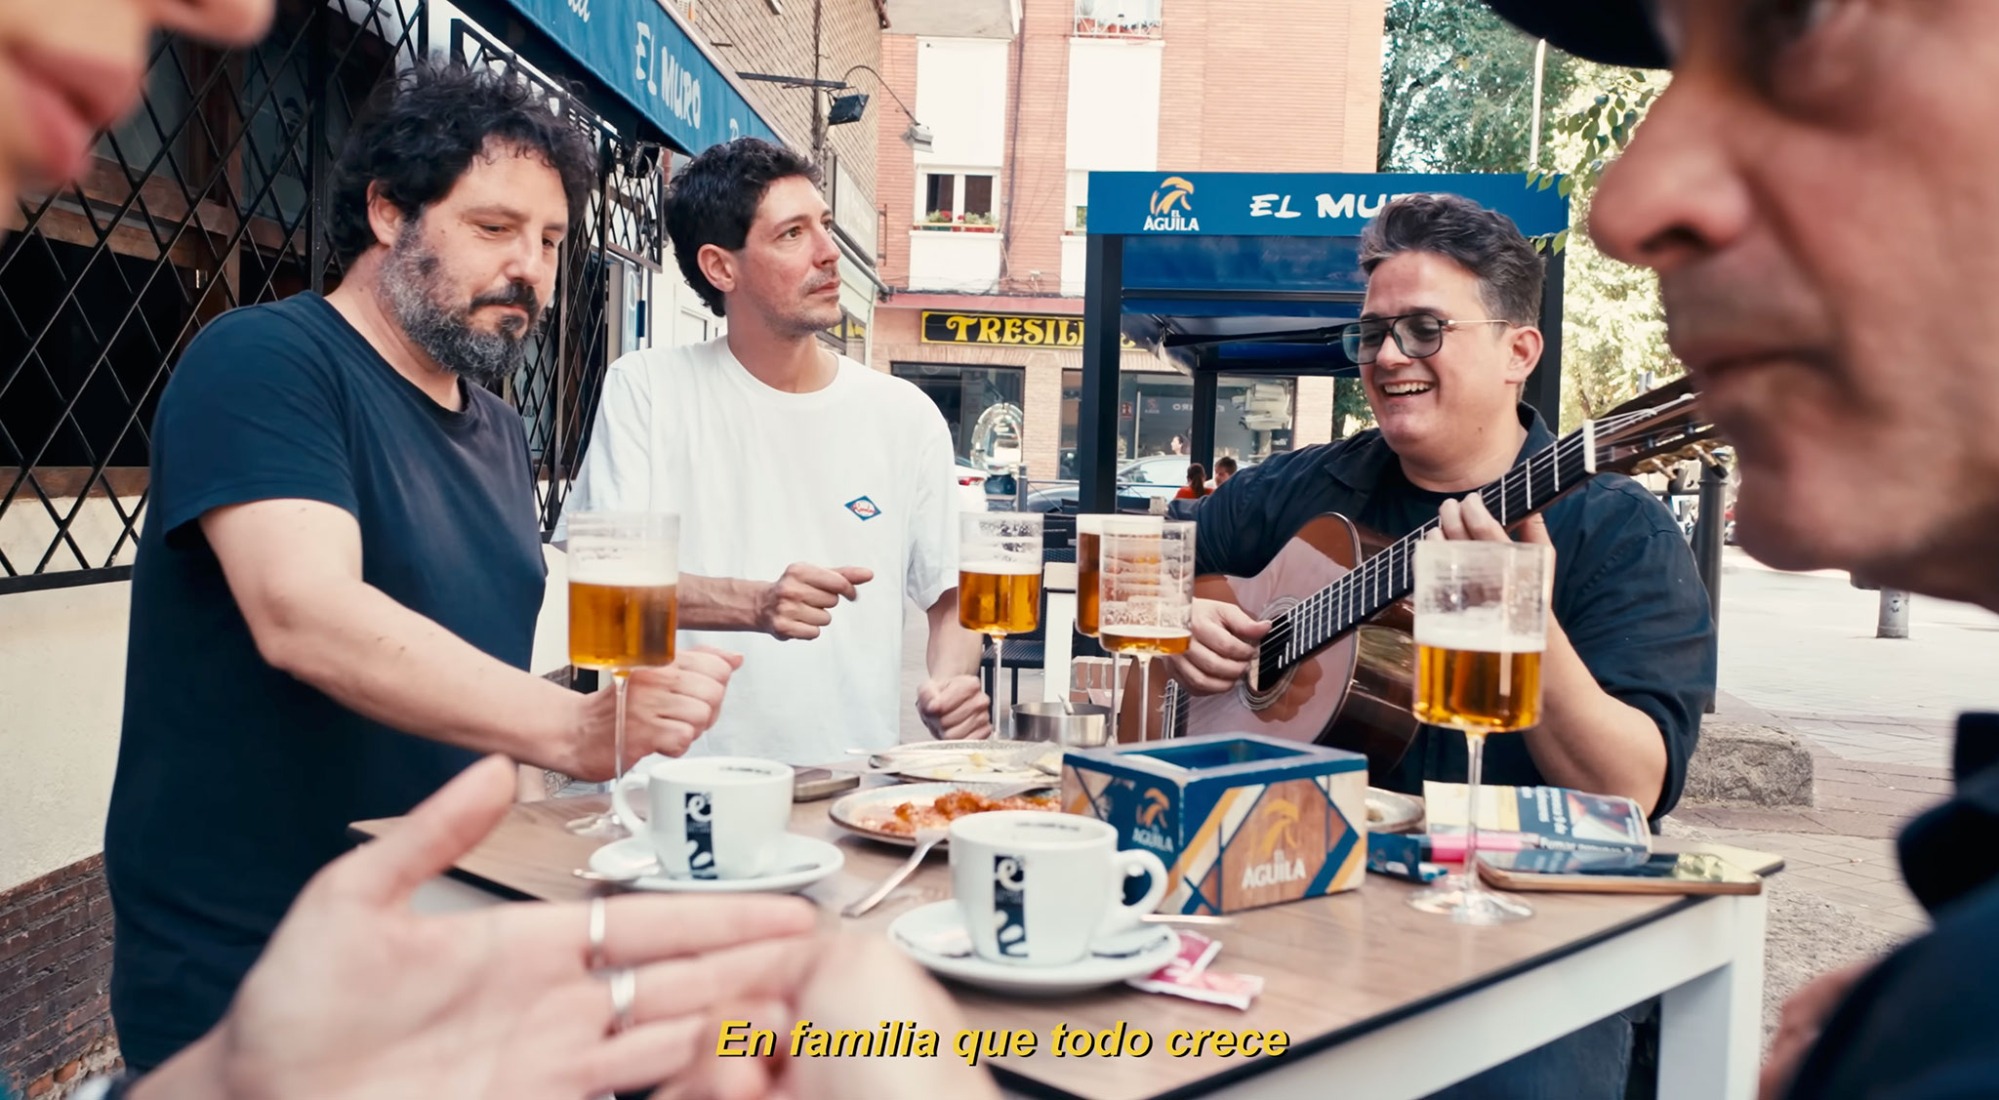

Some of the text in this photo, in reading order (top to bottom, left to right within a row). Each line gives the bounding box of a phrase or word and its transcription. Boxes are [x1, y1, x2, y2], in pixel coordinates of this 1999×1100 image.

[662, 46, 700, 130] MURO
[1250, 193, 1440, 219] EL MU
[946, 316, 1136, 348] TRESIL
